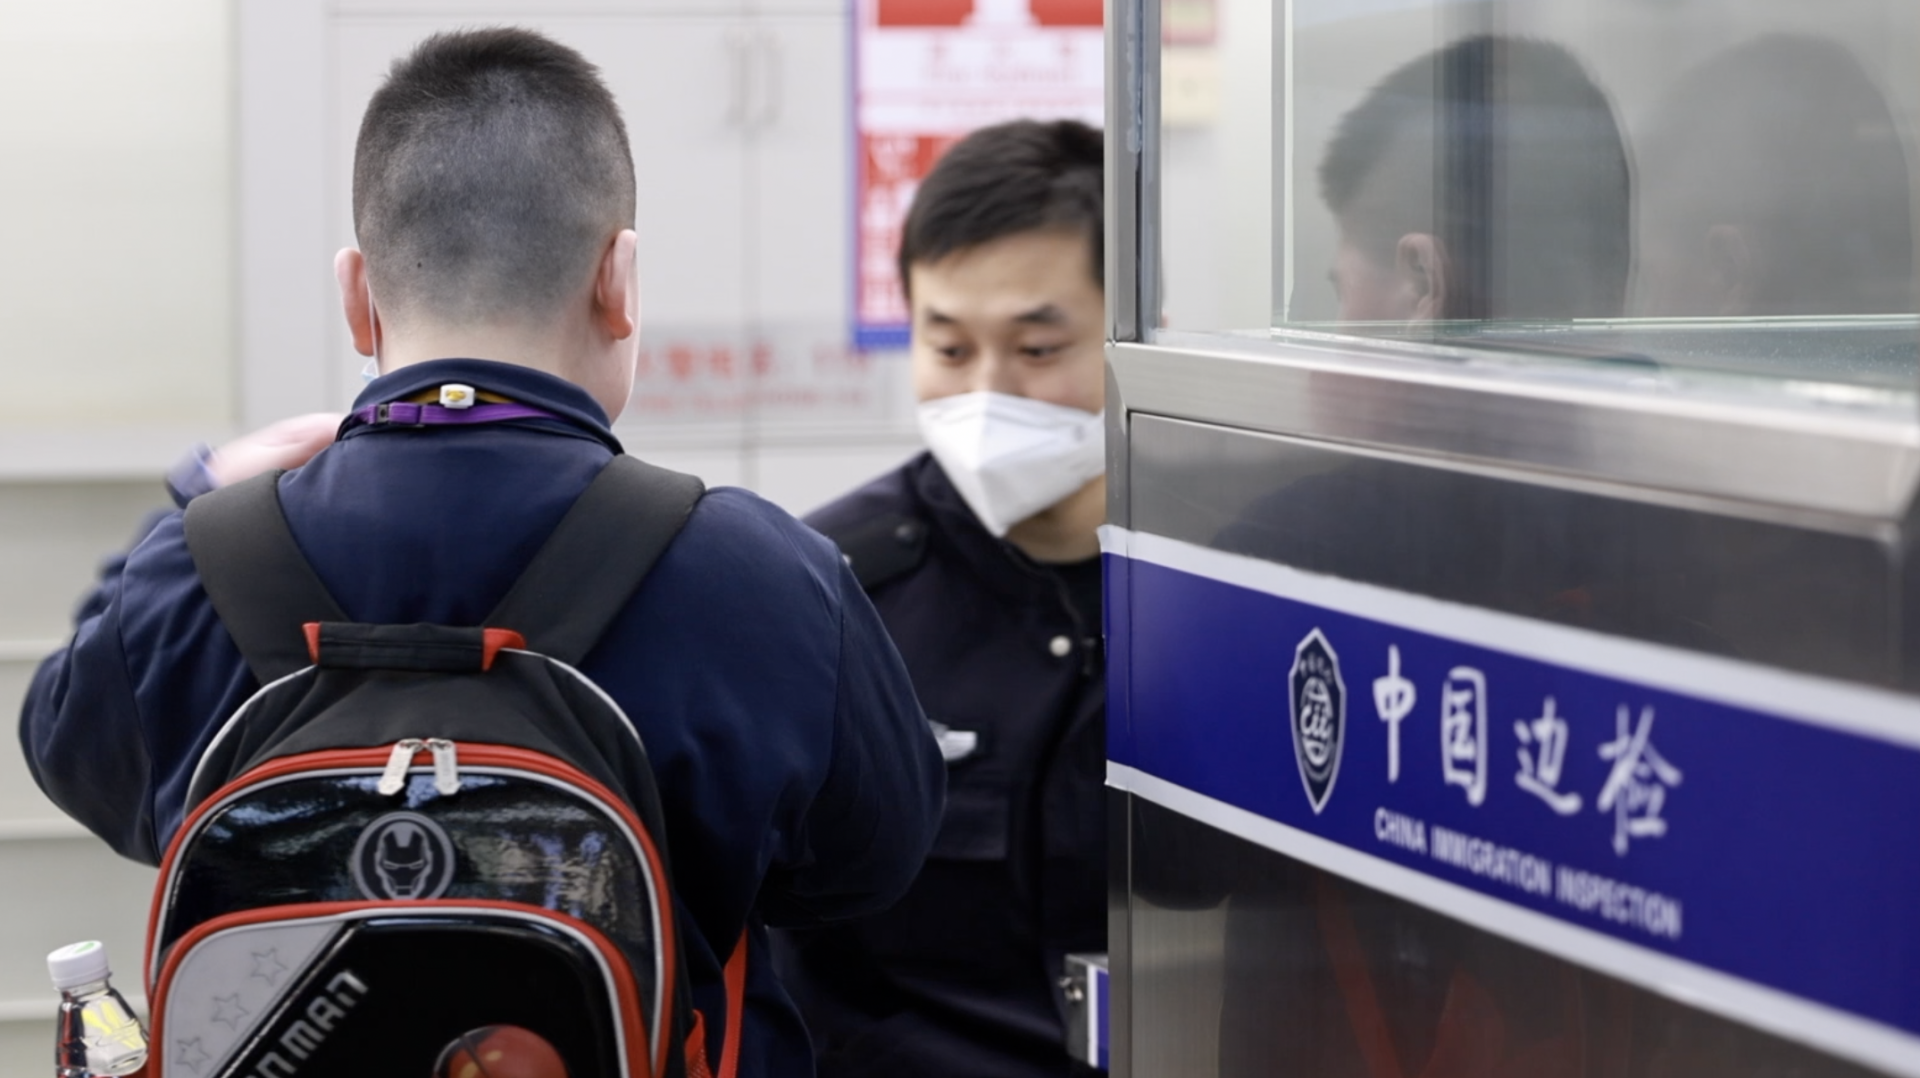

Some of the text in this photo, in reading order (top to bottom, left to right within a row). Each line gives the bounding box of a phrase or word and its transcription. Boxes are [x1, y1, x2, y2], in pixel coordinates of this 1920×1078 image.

[1372, 643, 1683, 857] 中国边检
[1374, 807, 1683, 939] CHINA IMMIGRATION INSPECTION
